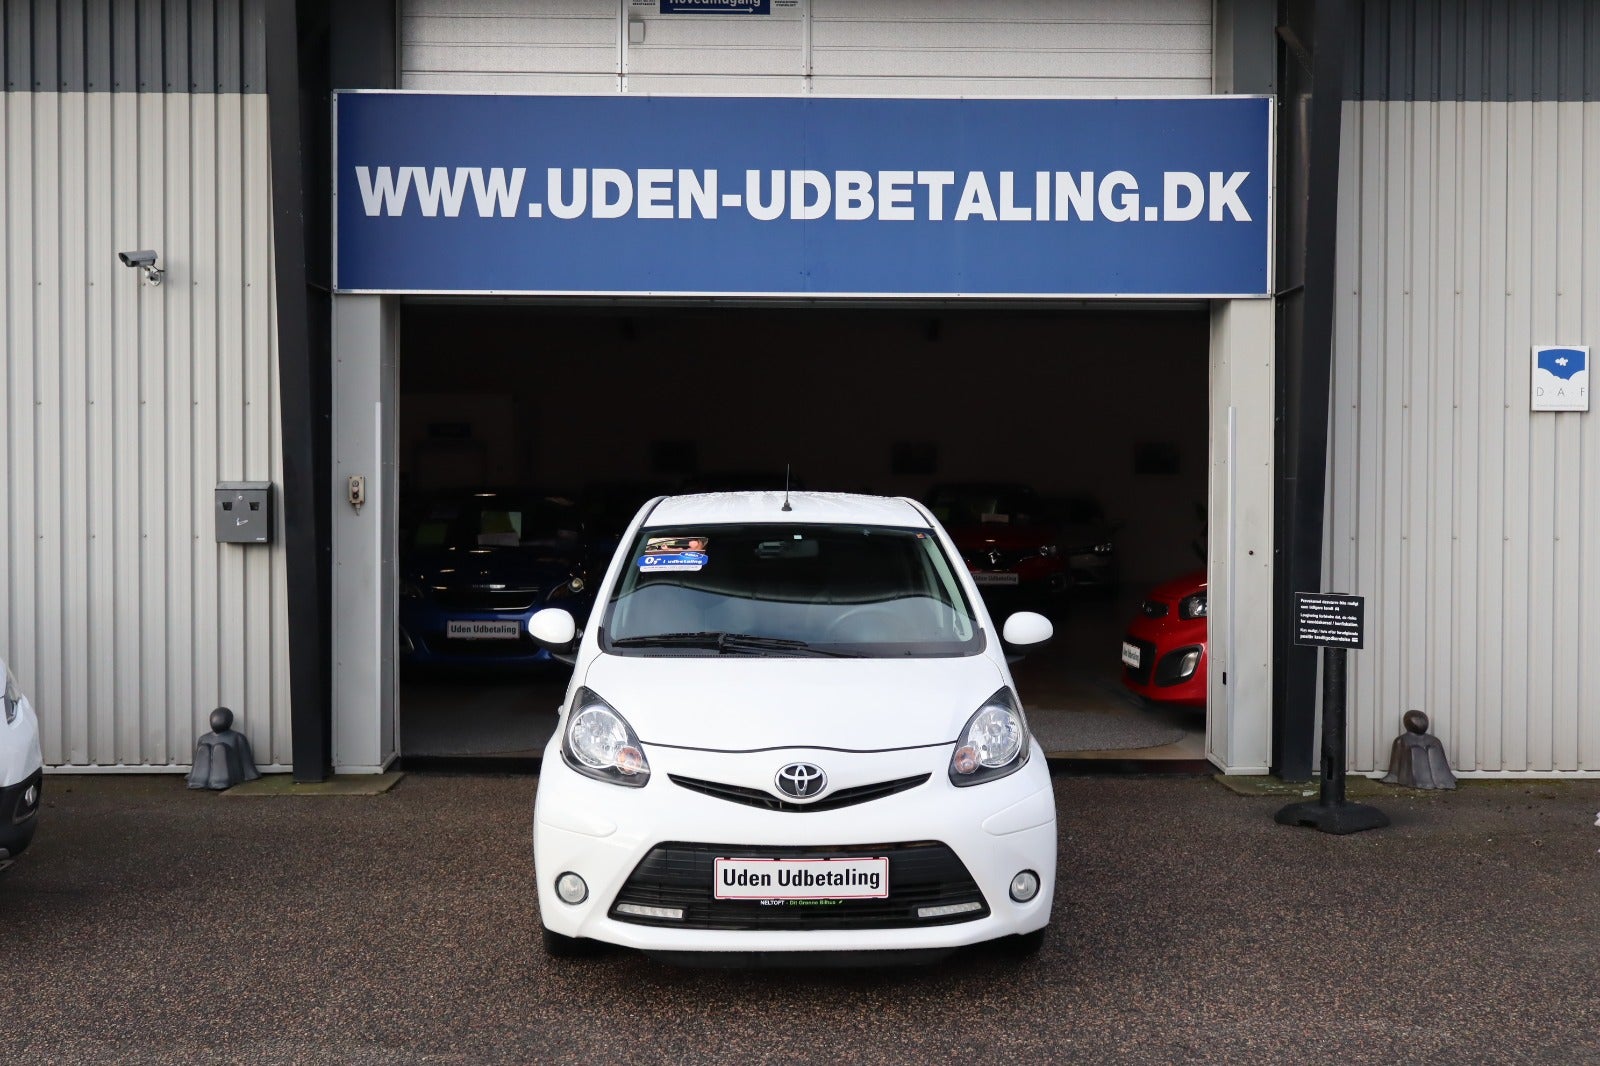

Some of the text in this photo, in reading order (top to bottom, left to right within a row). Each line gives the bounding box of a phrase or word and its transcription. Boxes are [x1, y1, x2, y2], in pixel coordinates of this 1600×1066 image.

[356, 167, 1252, 222] WWW.UDEN-UDBETALING.DK
[474, 625, 516, 634] Udbetaling
[724, 868, 880, 889] Uden Udbetaling
